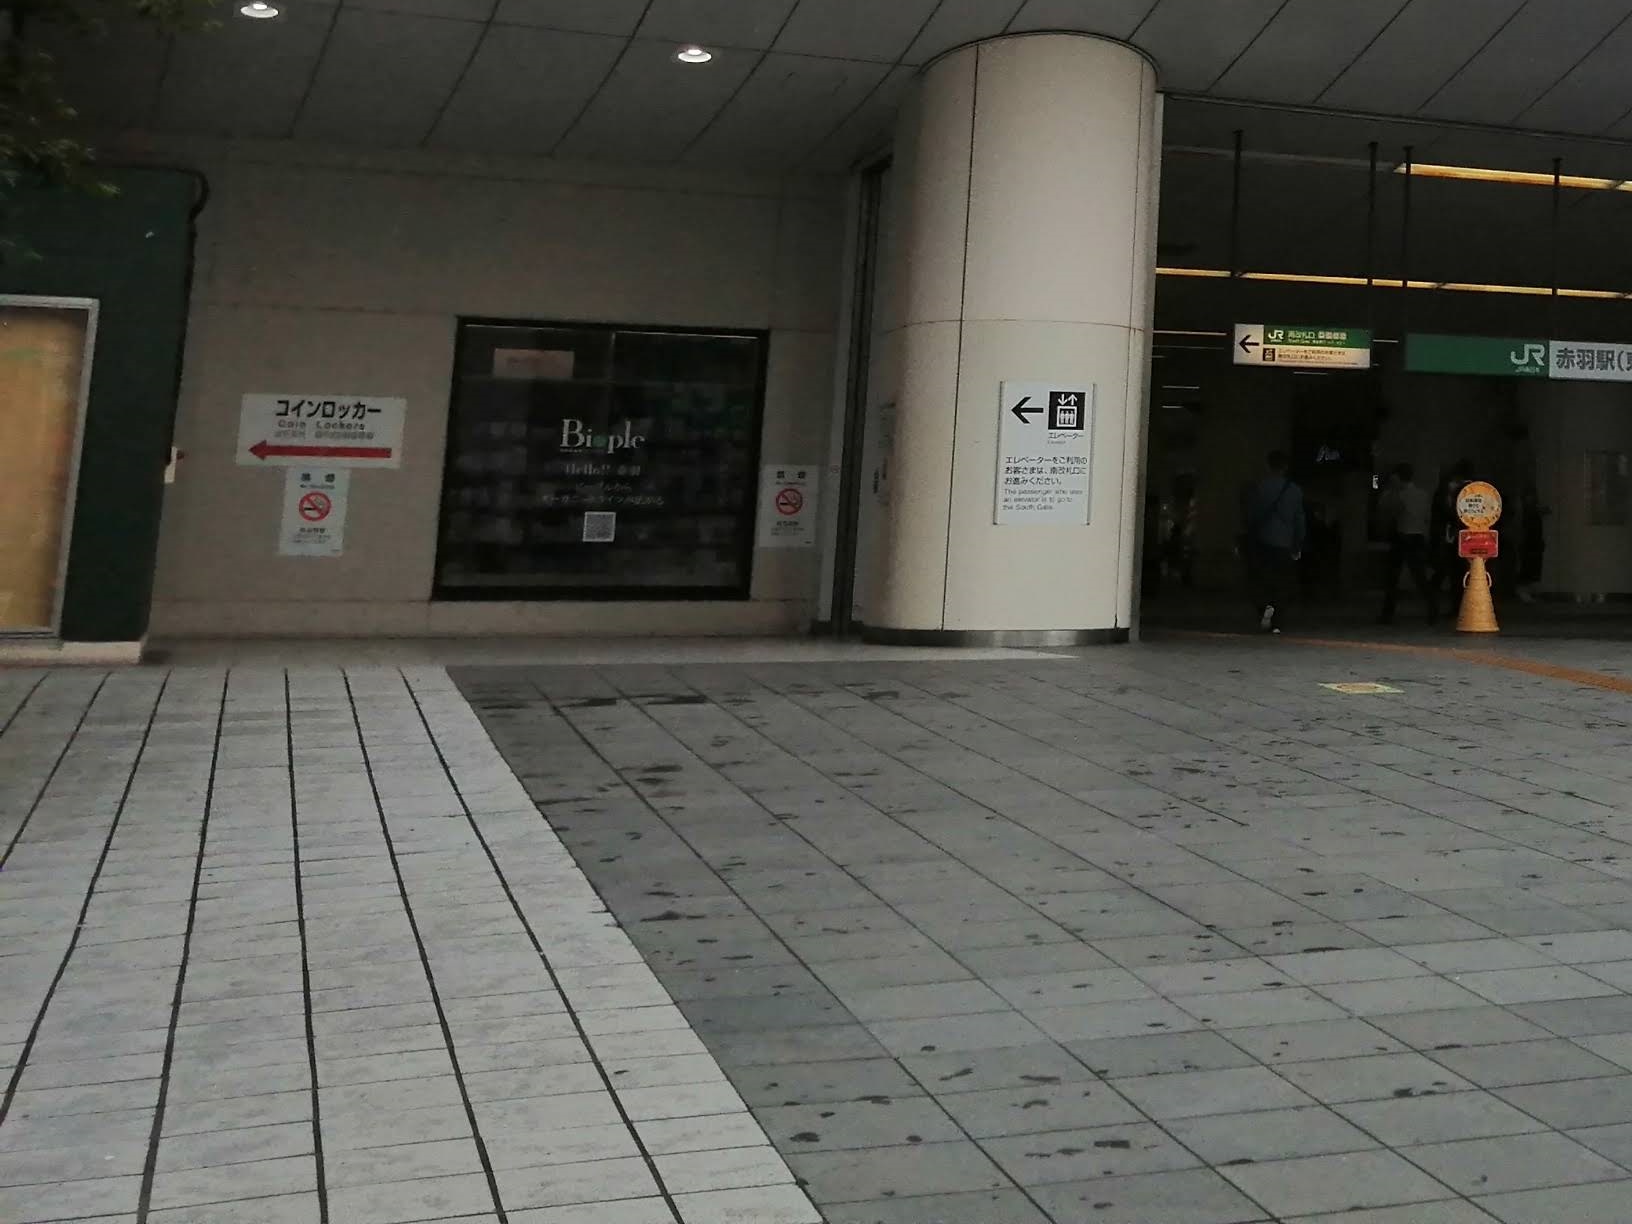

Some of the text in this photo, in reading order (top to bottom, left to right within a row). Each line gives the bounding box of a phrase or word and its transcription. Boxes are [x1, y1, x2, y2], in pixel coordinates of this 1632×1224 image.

[1268, 329, 1284, 339] JR
[1510, 343, 1545, 366] JR
[275, 399, 382, 421] コインロッカー
[1048, 431, 1084, 440] エレベーター
